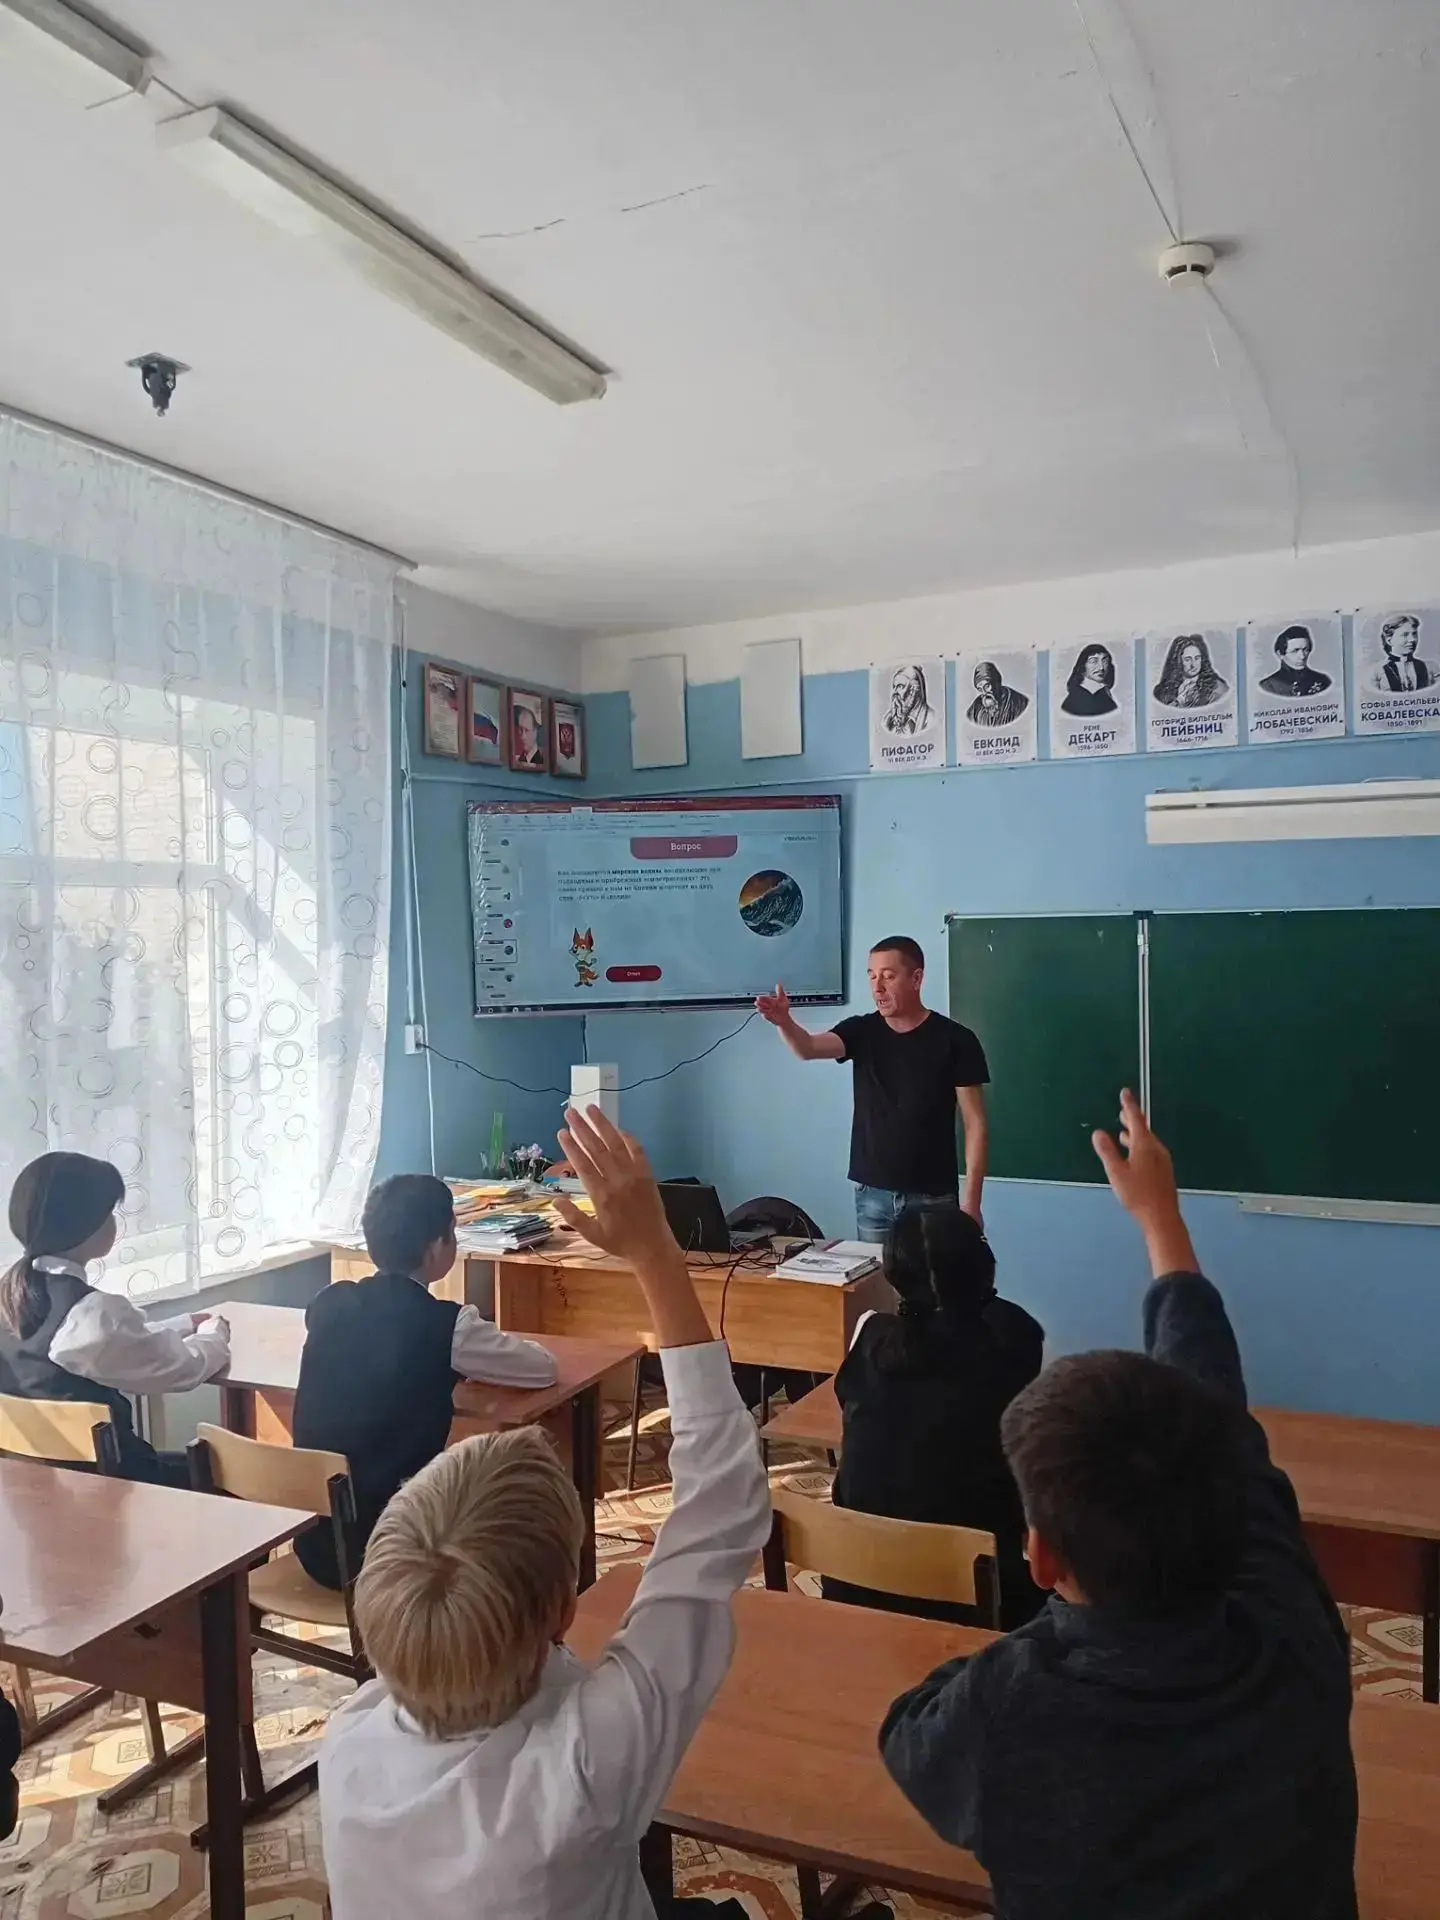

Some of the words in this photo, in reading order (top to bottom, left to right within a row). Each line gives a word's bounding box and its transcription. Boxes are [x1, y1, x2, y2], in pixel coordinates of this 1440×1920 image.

[1294, 703, 1339, 714] ИВАНОВИЧ
[1361, 700, 1391, 709] СОФЬЯ
[1188, 713, 1233, 723] ВИЛЬГЕЛЬМ
[1255, 711, 1338, 730] ЛОБАЧЕВСКИЙ
[1161, 721, 1223, 737] ЛЕЙБНИЦ
[973, 736, 1020, 749] ЕВКЛИД
[1068, 730, 1117, 746] ДЕКАРТ
[881, 743, 935, 757] ПИФАГОР
[670, 842, 702, 852] Вопрос
